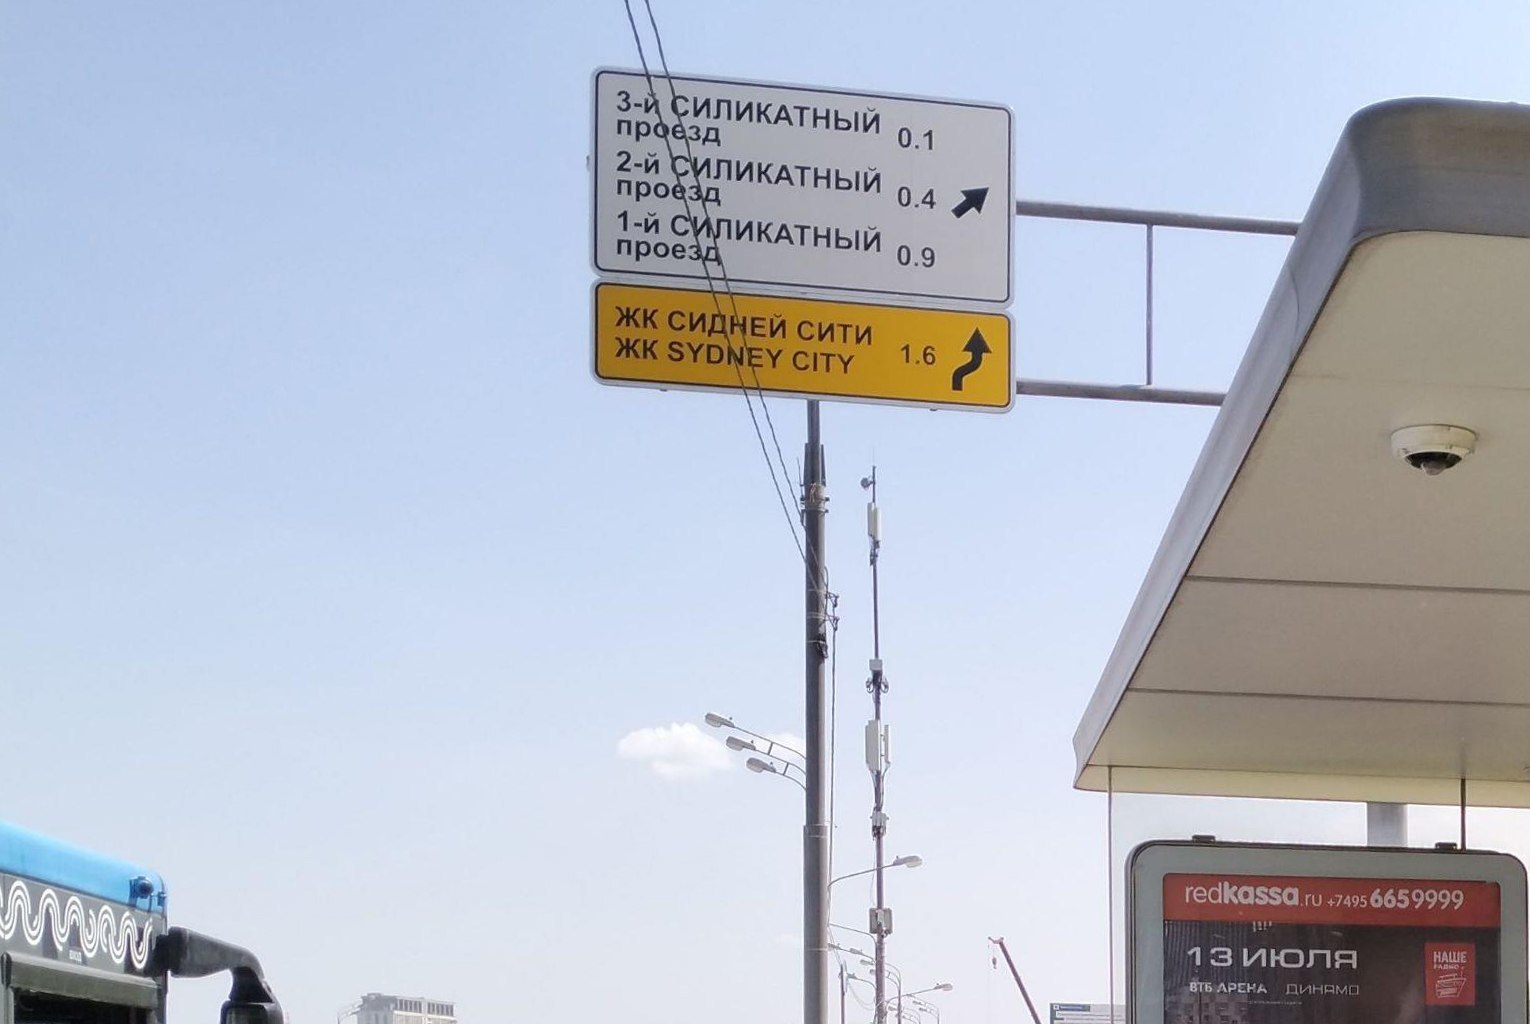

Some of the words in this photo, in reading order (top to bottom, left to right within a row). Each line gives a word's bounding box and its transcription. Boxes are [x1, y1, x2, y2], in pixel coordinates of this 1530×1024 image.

[616, 89, 660, 115] 3-й
[671, 94, 882, 134] СИЛИКАТНЫЙ
[897, 128, 934, 150] 0.1
[616, 119, 721, 146] проезд
[616, 150, 660, 175] 2-й
[671, 154, 882, 194] СИЛИКАТНЫЙ
[897, 186, 937, 209] 0.4
[616, 179, 721, 206] проезд
[616, 238, 721, 266] проезд
[617, 210, 660, 234] 1-й
[670, 214, 882, 253] СИЛИКАТНЫЙ
[897, 245, 936, 268] 0.9
[615, 306, 659, 330] ЖК
[667, 310, 787, 340] СИДНЕЙ
[797, 320, 873, 346] СИТИ
[900, 344, 936, 366] 1.6
[615, 337, 659, 361] ЖК
[667, 342, 784, 371] SYDNEY
[792, 350, 855, 374] CITY
[1185, 881, 1322, 907] redkassa.ru
[1327, 895, 1367, 908] +7495
[1370, 888, 1464, 910] 6659999
[1187, 946, 1234, 969] 13
[1243, 947, 1358, 970] ИЮЛЯ
[1433, 950, 1467, 963] НАШЕ
[1190, 981, 1213, 993] ВТБ
[1217, 982, 1268, 995] АРЕНА
[1286, 983, 1360, 996] ДИНАМО
